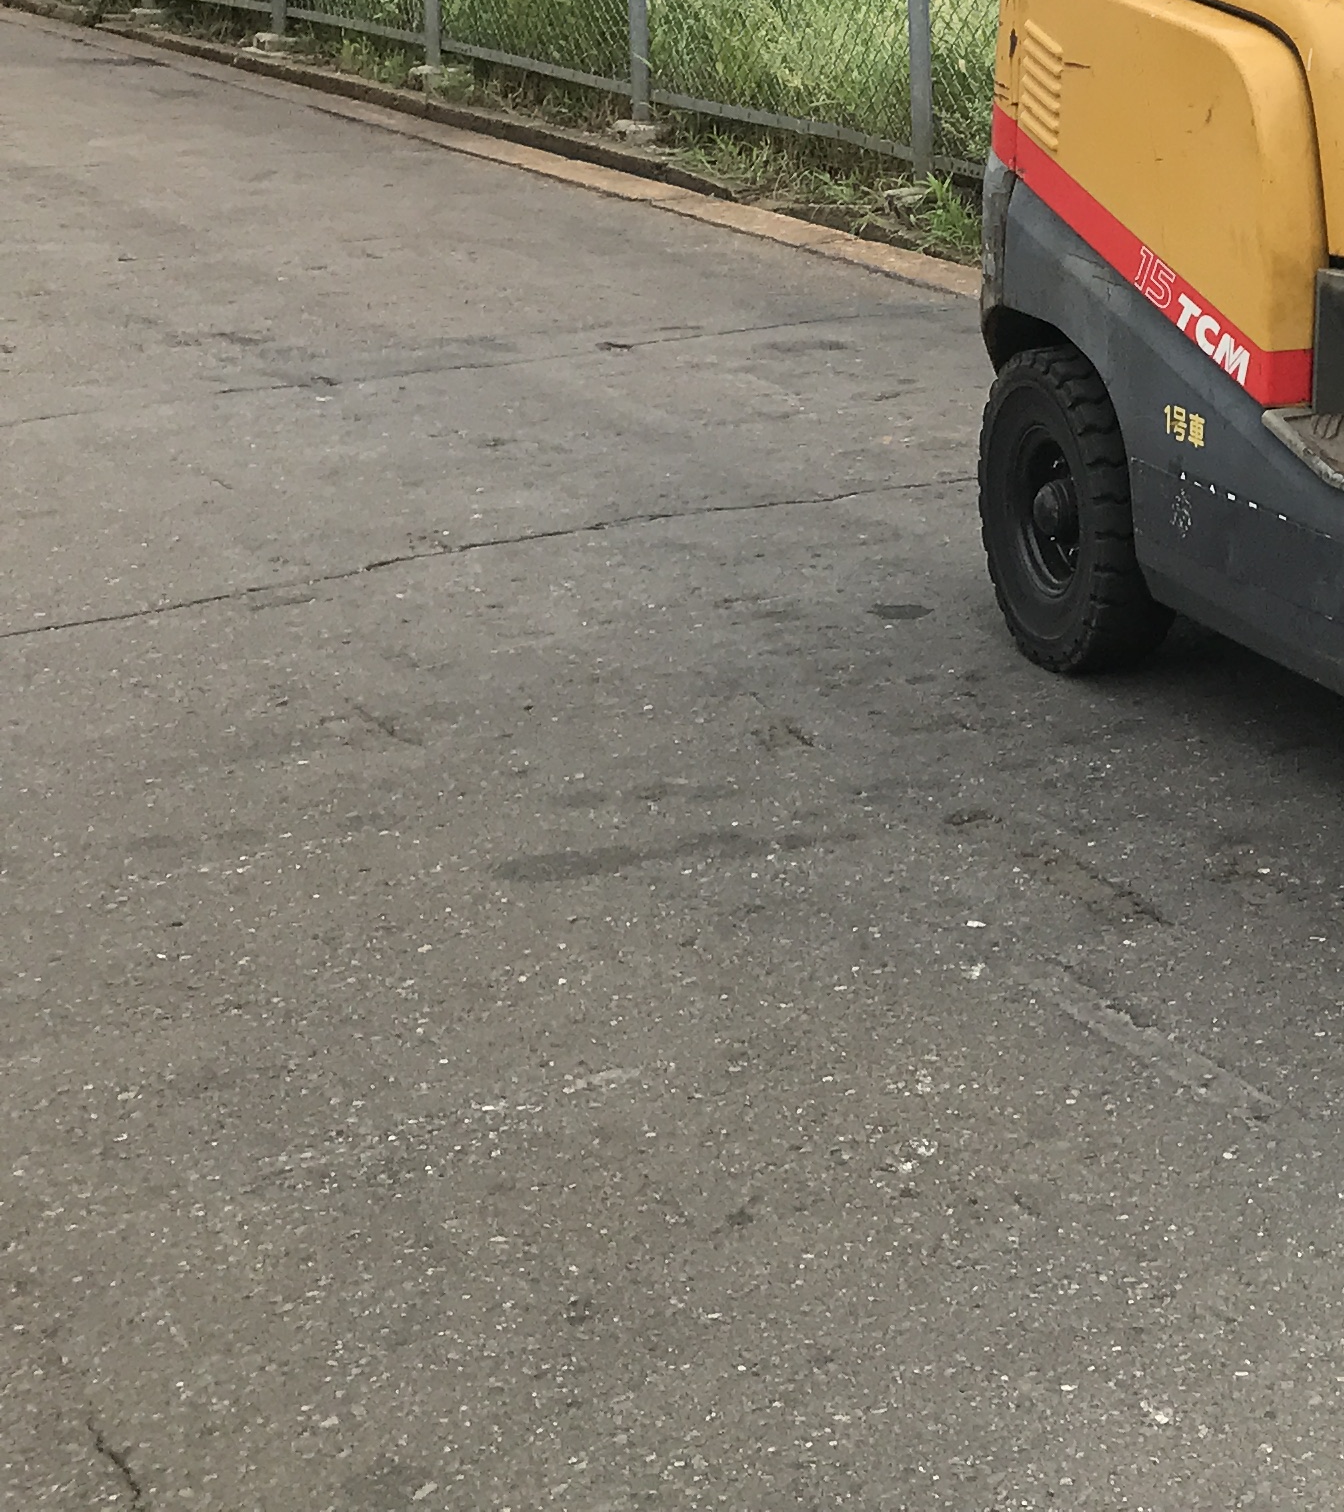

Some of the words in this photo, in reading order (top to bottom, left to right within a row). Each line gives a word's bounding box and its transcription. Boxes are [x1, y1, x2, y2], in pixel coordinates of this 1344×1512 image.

[1133, 245, 1177, 309] 15
[1176, 292, 1251, 386] TCM
[1163, 404, 1206, 449] 1号車
